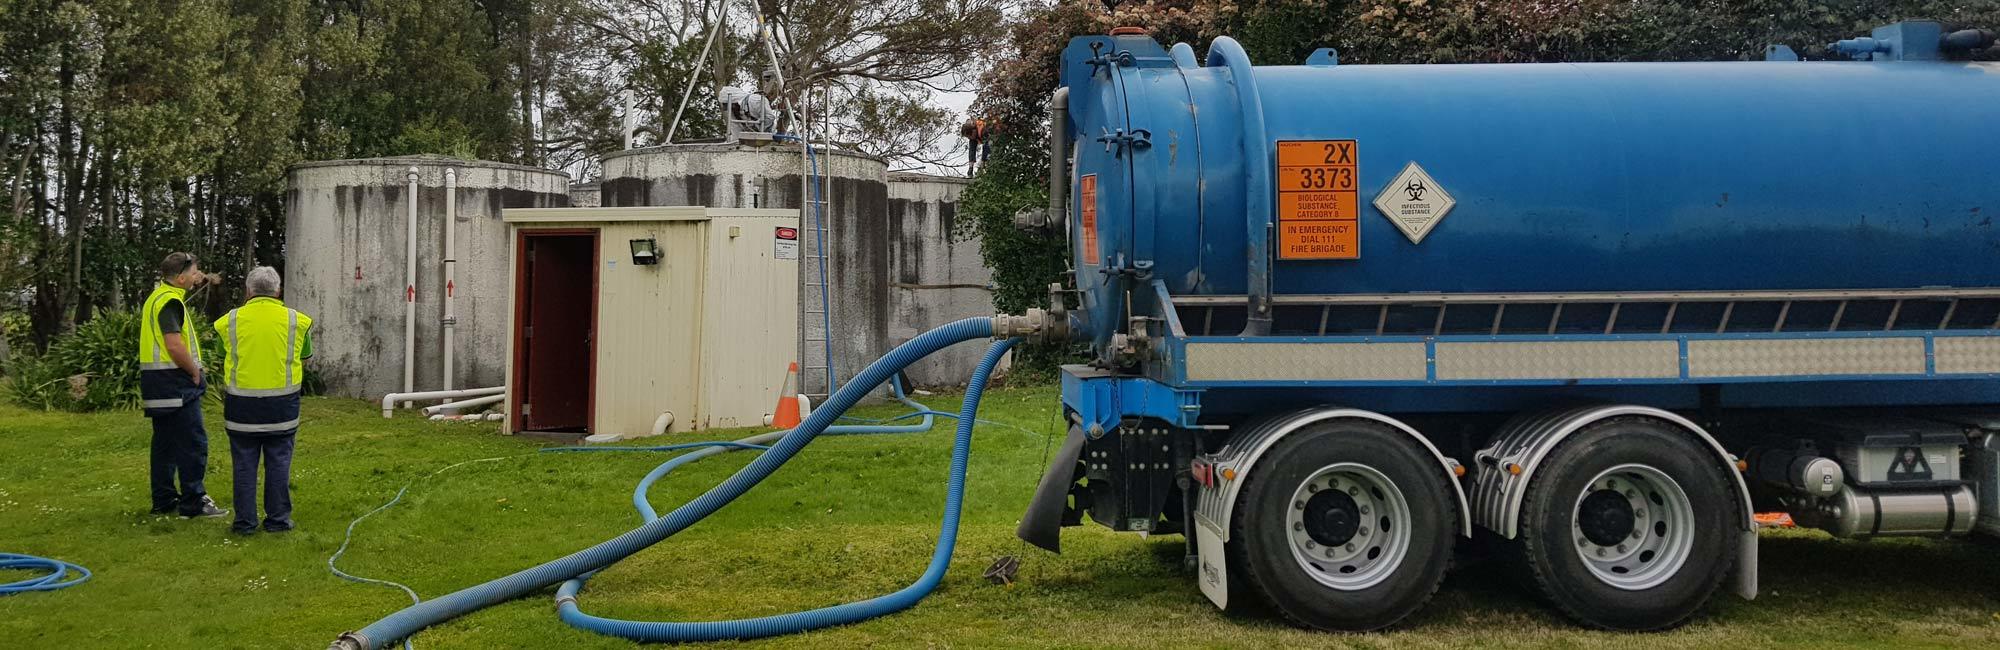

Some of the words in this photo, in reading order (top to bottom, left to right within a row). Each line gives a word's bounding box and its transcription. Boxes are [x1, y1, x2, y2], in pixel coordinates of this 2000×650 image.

[1324, 143, 1351, 164] 2X
[1301, 168, 1351, 189] 3373
[1298, 194, 1337, 202] BIOLOGICAL
[1297, 210, 1332, 218] CATEGORY
[1288, 226, 1296, 234] IN
[1299, 225, 1349, 234] EMERGENCY
[1301, 235, 1320, 243] DIAL
[1322, 235, 1335, 243] 111
[1291, 245, 1309, 253] FIRE
[1311, 244, 1346, 253] BRIGADE
